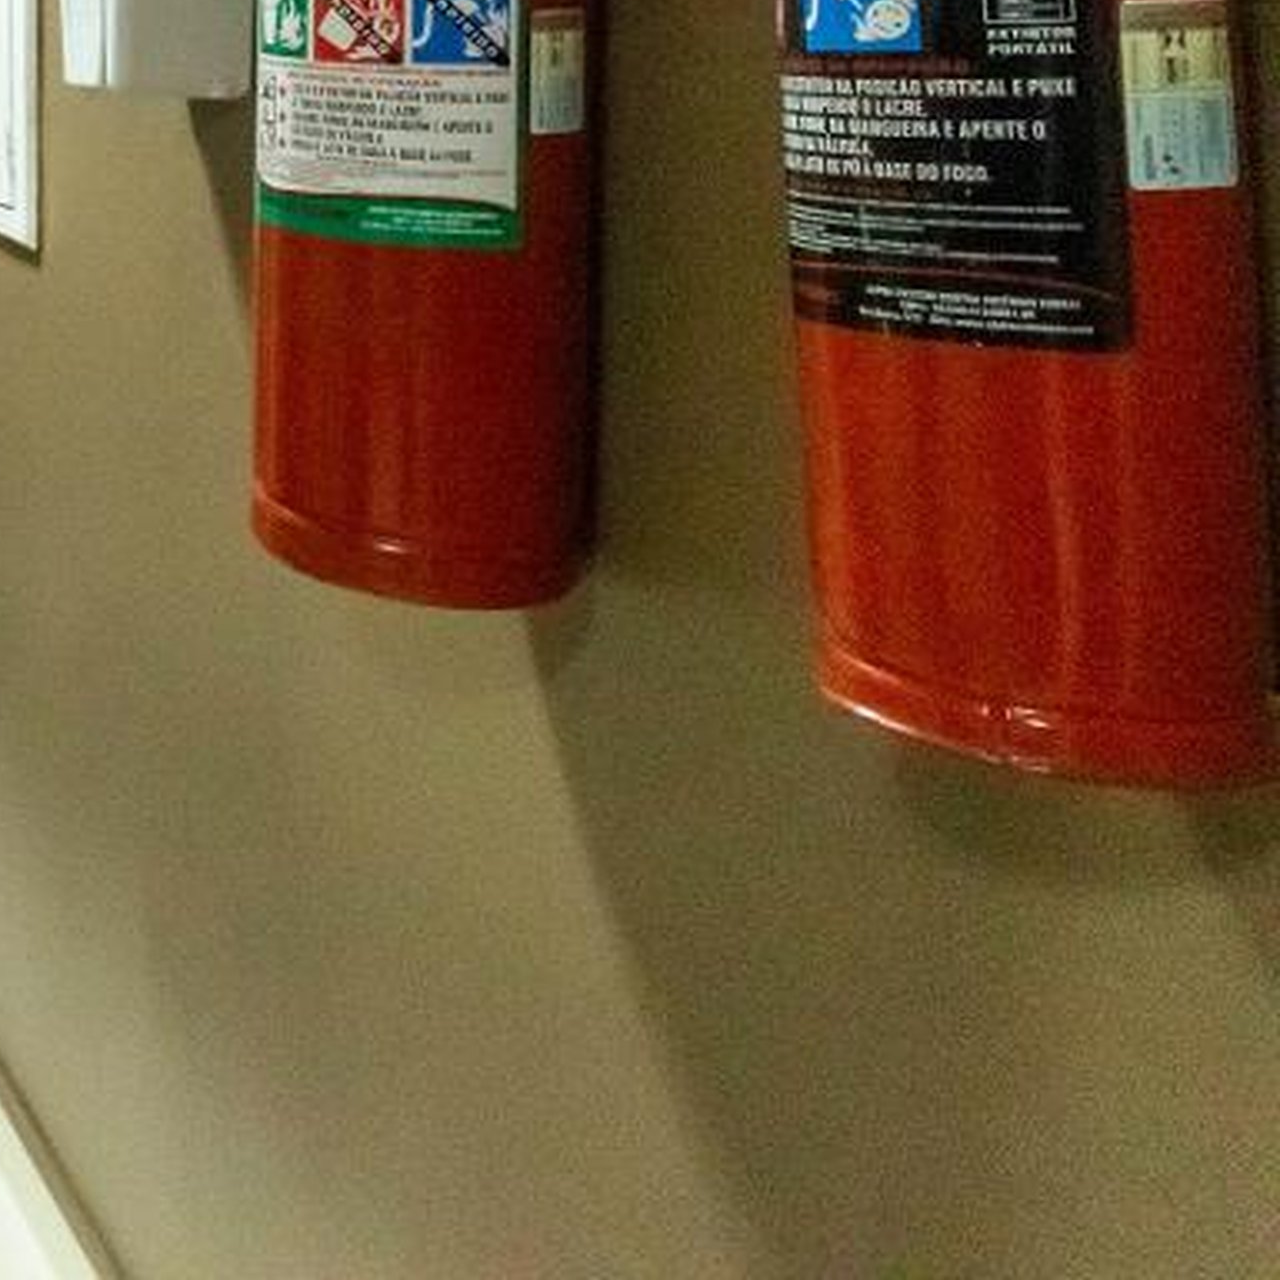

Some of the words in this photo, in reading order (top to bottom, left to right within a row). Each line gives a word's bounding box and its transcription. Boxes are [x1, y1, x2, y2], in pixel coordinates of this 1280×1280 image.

[924, 77, 1007, 97] VERTICAL
[1011, 77, 1024, 96] E
[943, 120, 955, 140] E
[1032, 120, 1046, 141] O
